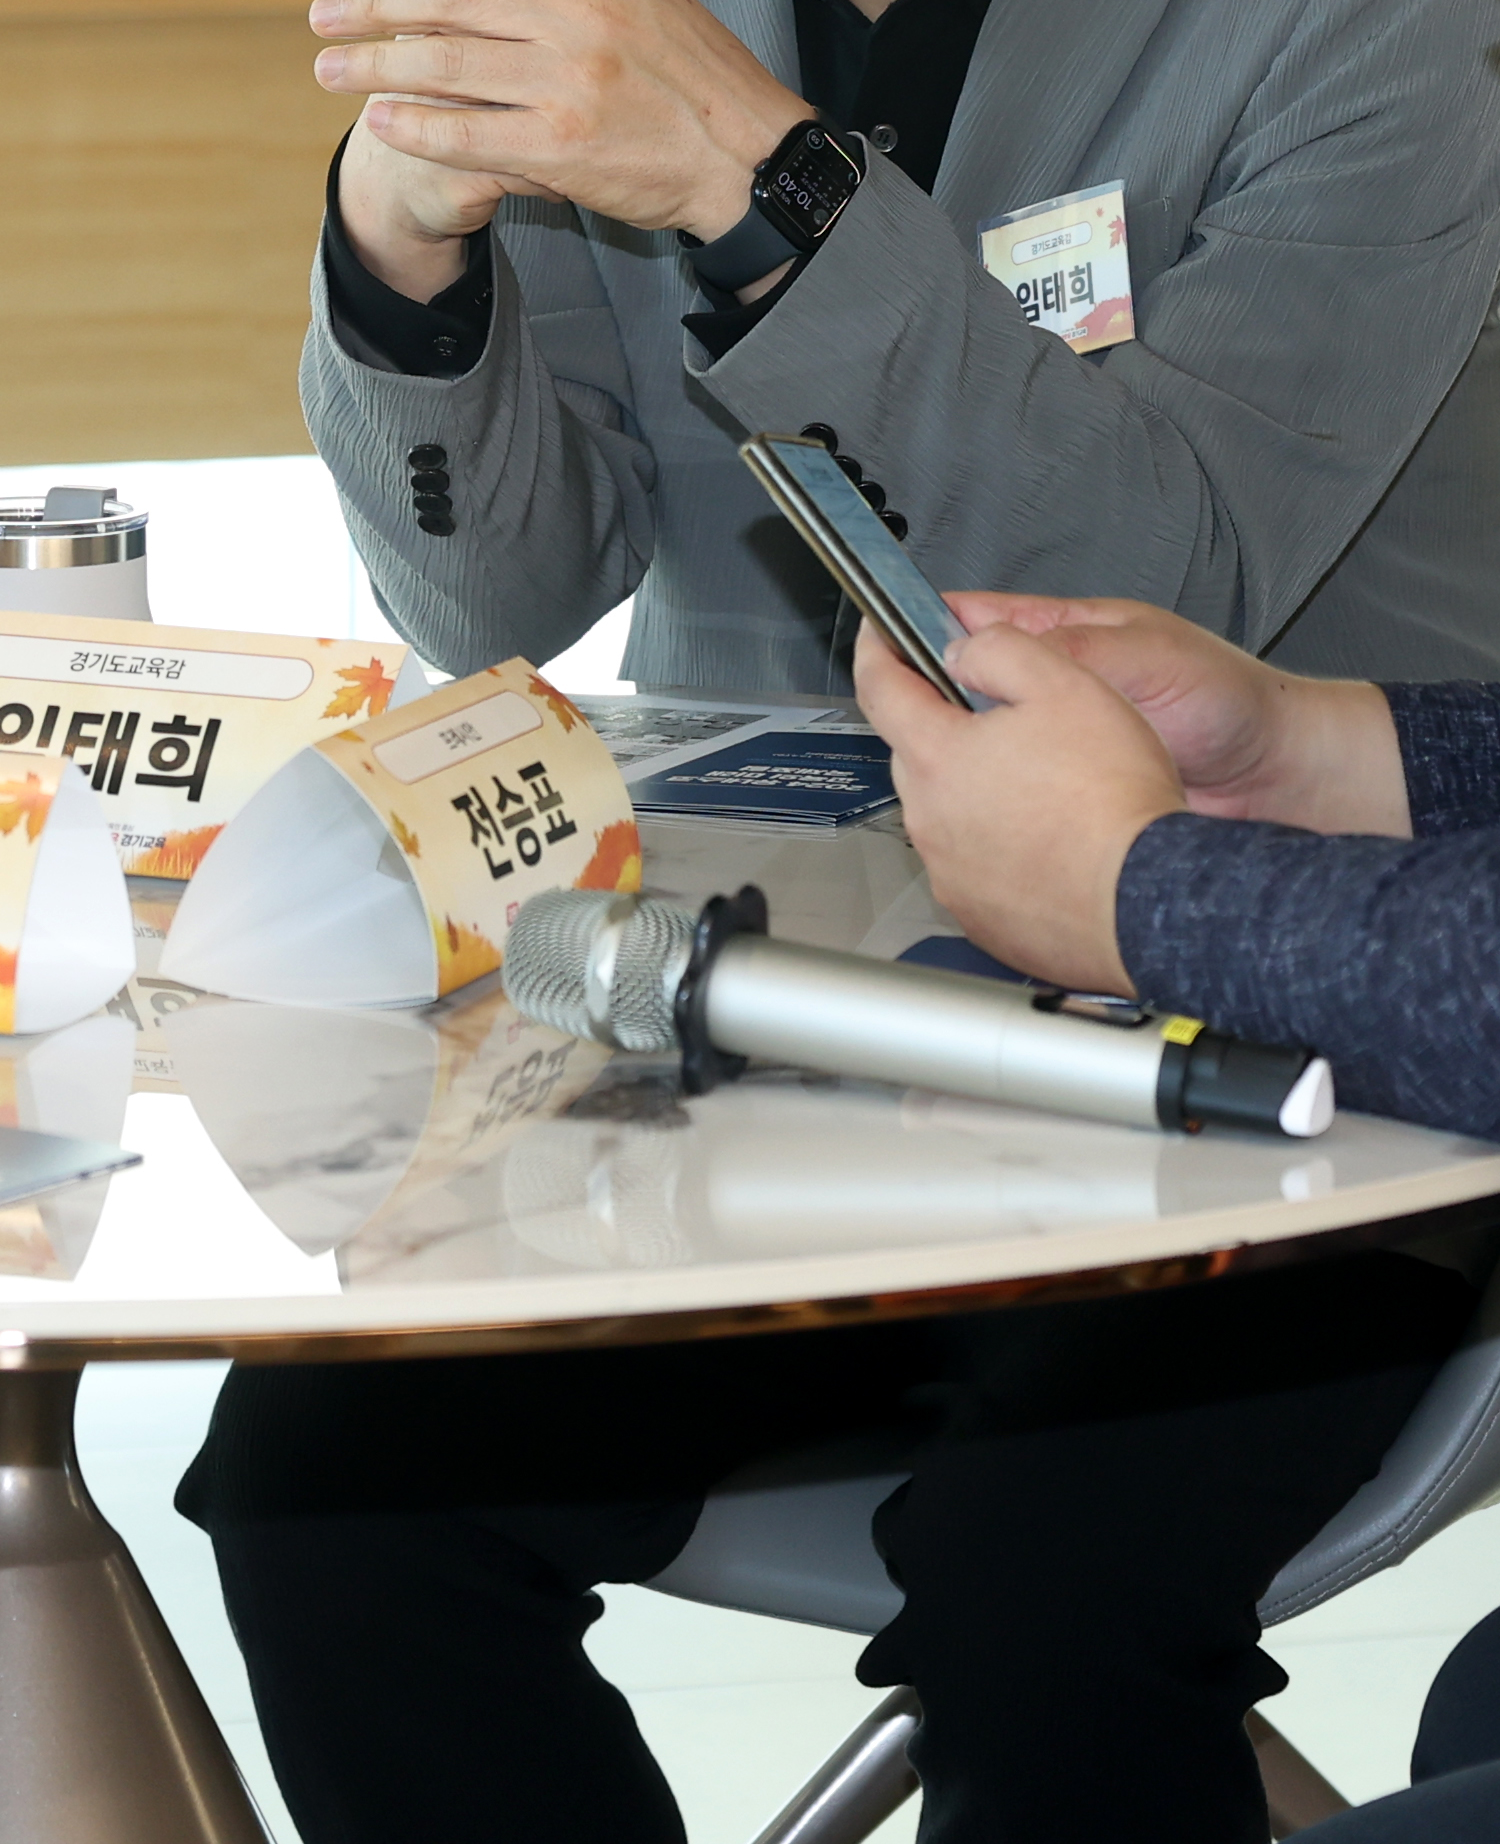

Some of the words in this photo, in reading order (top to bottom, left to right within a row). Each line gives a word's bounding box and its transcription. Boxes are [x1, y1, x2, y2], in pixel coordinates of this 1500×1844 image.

[778, 172, 813, 211] 10:40
[1031, 232, 1072, 256] 경기도교육감
[1016, 261, 1095, 324] 임태희
[69, 651, 187, 680] 경기도교육감
[786, 780, 871, 792] 2024
[451, 761, 578, 882] 전승표
[121, 834, 167, 849] 경기교육
